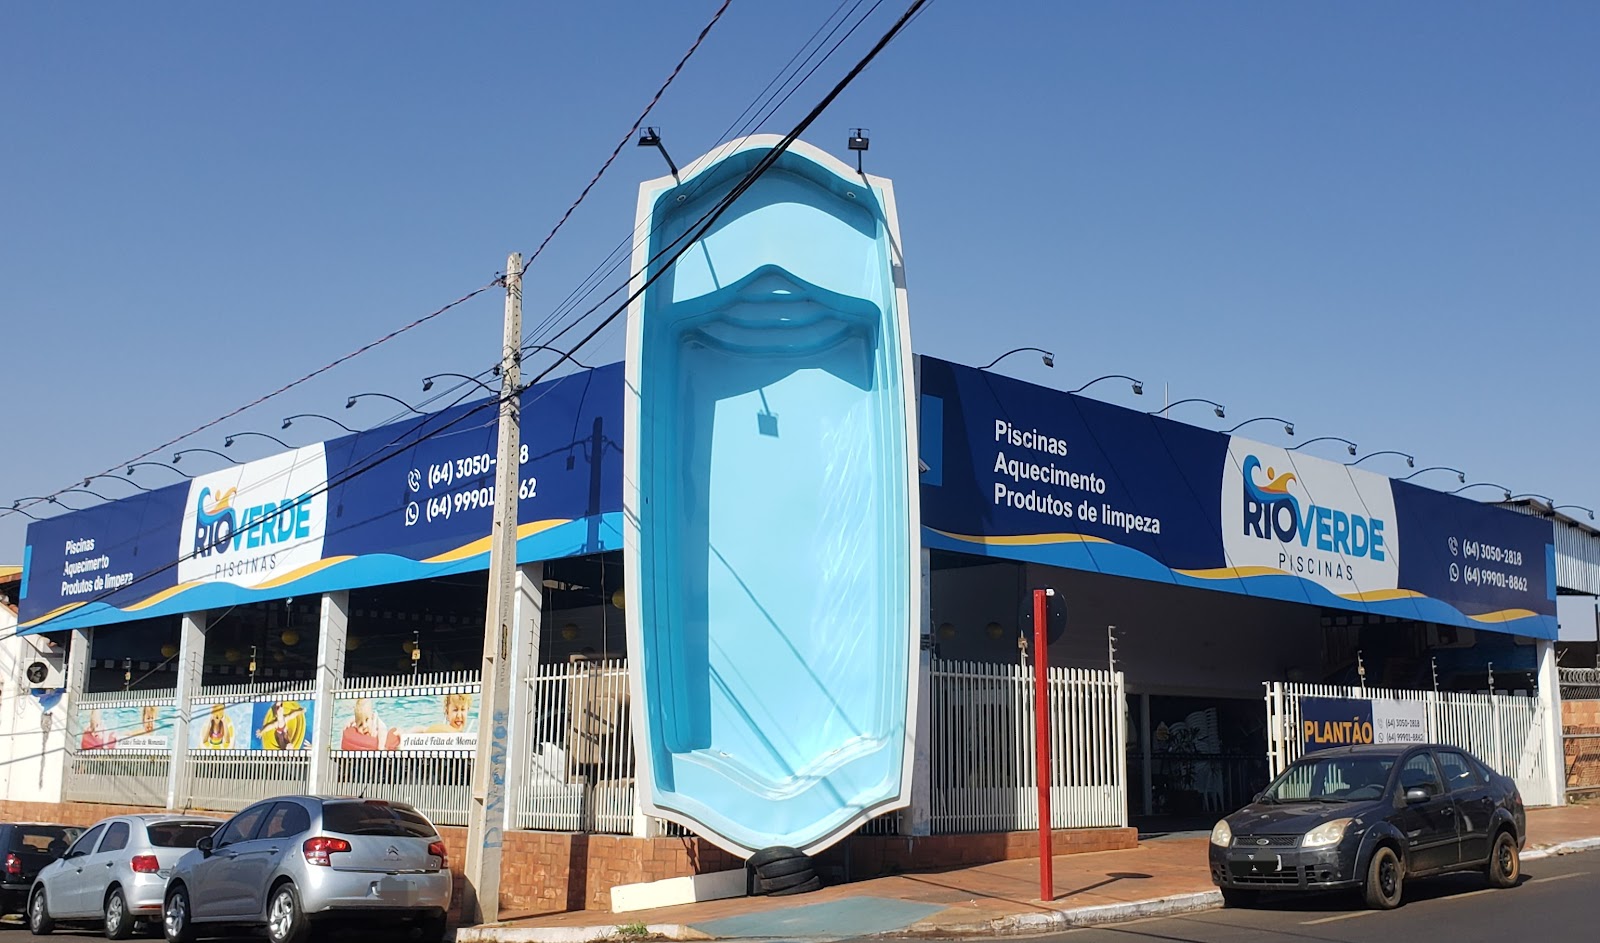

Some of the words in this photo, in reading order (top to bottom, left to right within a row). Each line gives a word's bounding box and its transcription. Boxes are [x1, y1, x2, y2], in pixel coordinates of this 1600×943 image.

[995, 419, 1068, 456] Piscinas
[428, 460, 454, 489] (64)
[456, 444, 529, 479] 3050-8
[994, 452, 1106, 494] Aquecimento
[426, 494, 452, 523] (64)
[454, 478, 536, 512] 9990162
[994, 482, 1073, 518] Produtos
[1077, 500, 1097, 522] de
[1102, 504, 1161, 534] limpeza
[65, 538, 95, 556] Piscinas
[1463, 539, 1480, 561] (64)
[1481, 544, 1522, 566] 3050-2818
[63, 554, 109, 578] Aquecimento
[214, 554, 277, 579] PISCINAS
[1279, 552, 1353, 581] PISCINAS
[1463, 565, 1481, 587] (64)
[1481, 569, 1528, 592] 99901-8862
[61, 579, 93, 596] Produtos
[94, 575, 103, 591] de
[104, 572, 133, 590] limpeza
[404, 737, 410, 746] A
[410, 737, 424, 746] vida
[430, 736, 445, 746] Feita
[446, 737, 454, 746] de
[1304, 716, 1373, 744] PLANTÃO
